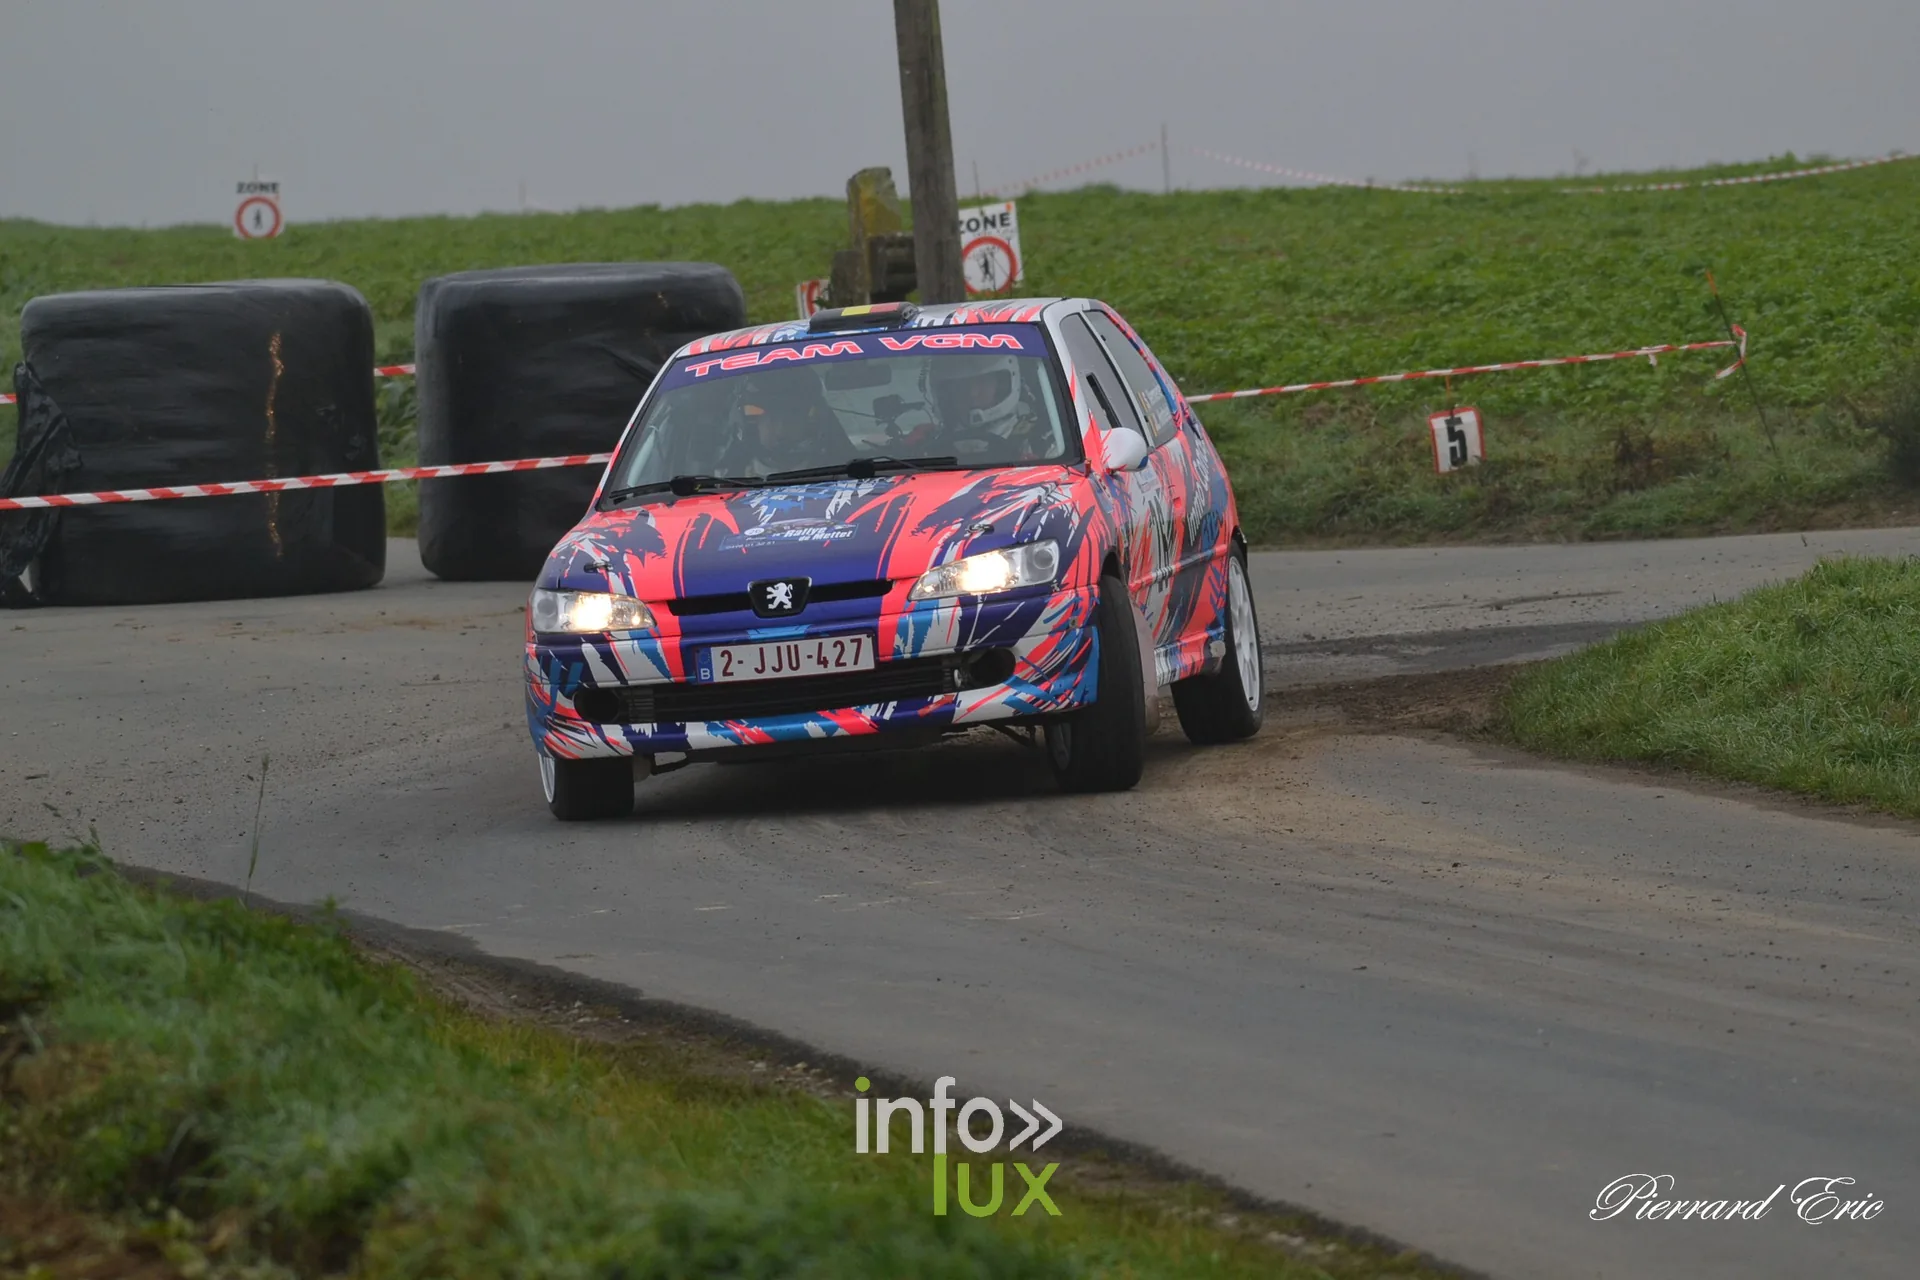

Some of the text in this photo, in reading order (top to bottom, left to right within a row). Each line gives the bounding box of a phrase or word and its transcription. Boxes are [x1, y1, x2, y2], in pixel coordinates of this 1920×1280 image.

[236, 182, 280, 194] ZONE
[685, 333, 1025, 378] TEAM VGM
[1444, 417, 1468, 466] 5
[784, 526, 827, 538] Rallye
[812, 530, 853, 541] Mettet
[700, 668, 711, 680] B
